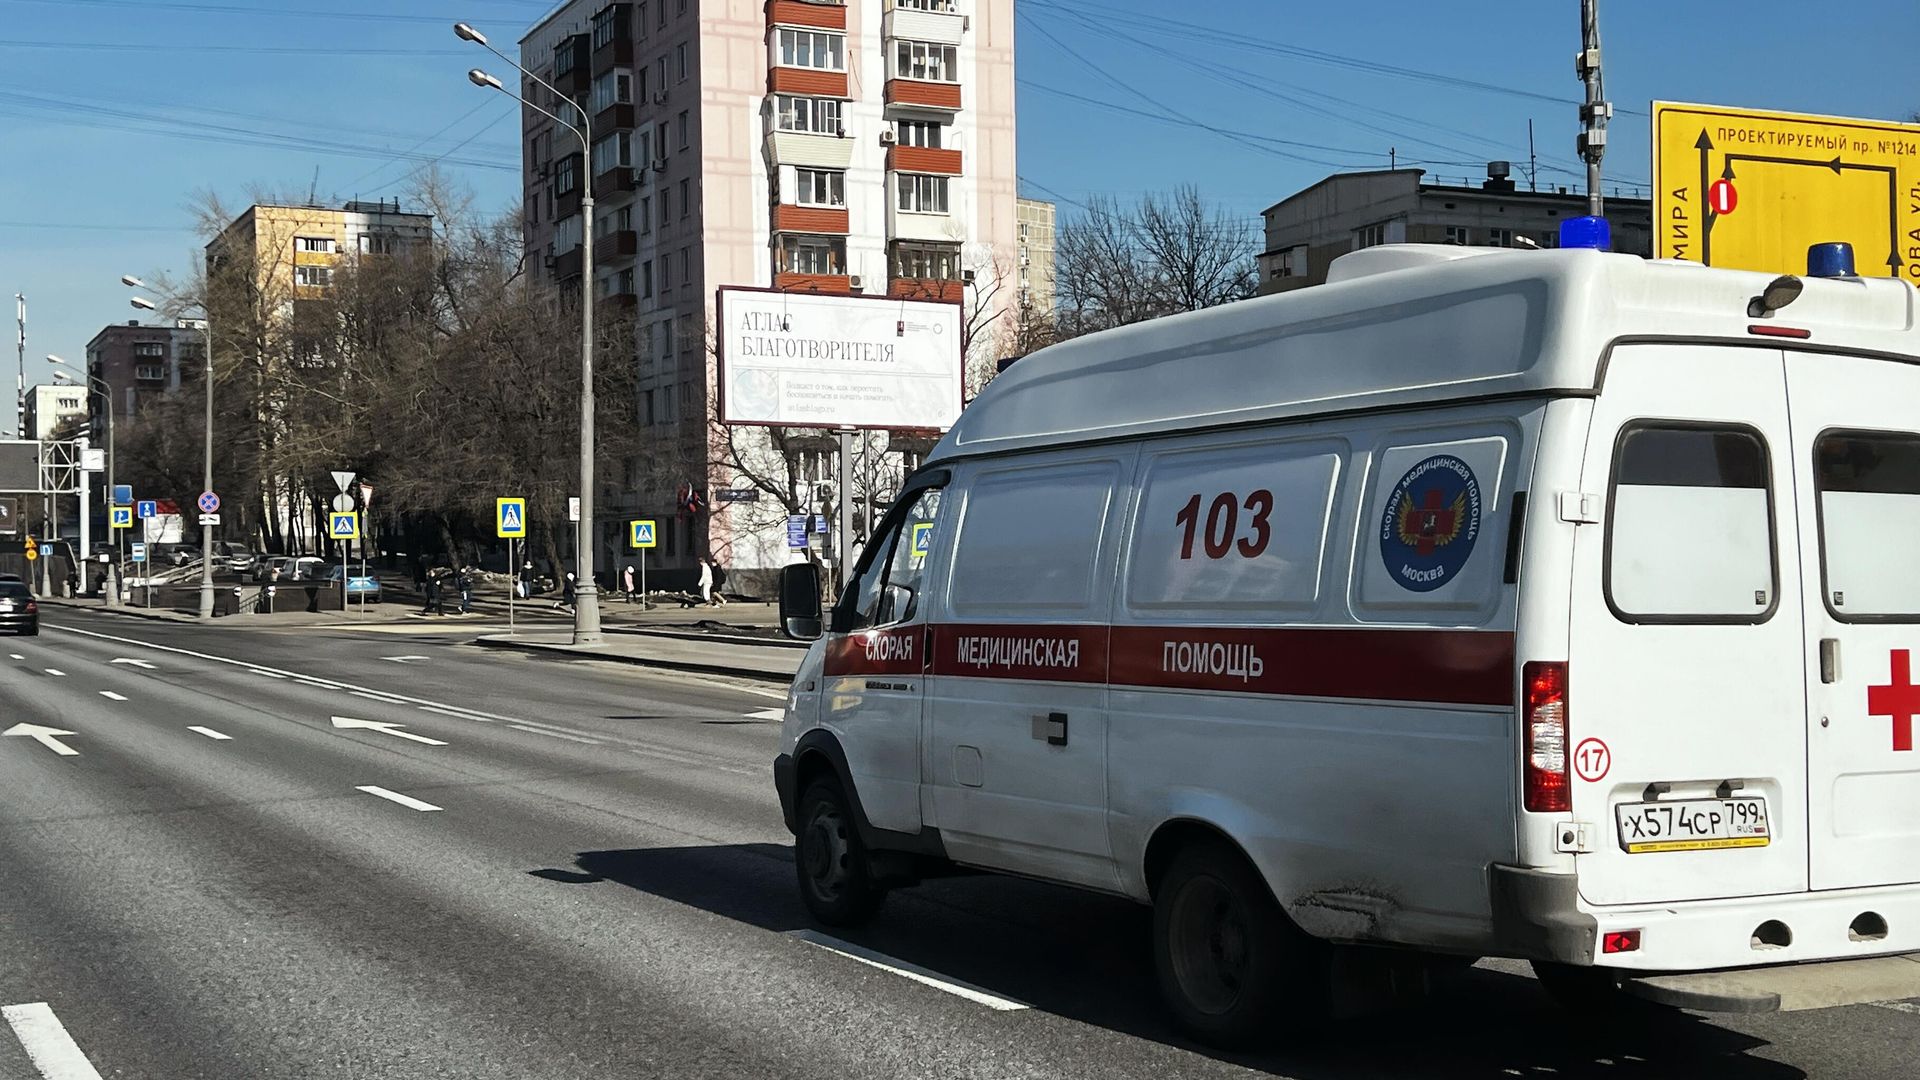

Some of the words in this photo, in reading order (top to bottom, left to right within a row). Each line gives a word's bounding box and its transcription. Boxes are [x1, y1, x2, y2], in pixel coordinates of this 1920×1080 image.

[1717, 127, 1847, 150] ПРОЕКТИРУЕМЫЙ
[1853, 142, 1873, 156] пр.
[1878, 140, 1917, 156] №1214
[1672, 187, 1688, 260] МИРА
[1909, 229, 1920, 290] ОВА
[741, 312, 793, 333] АТЛАС
[741, 336, 895, 363] БЛАГОТВОРИТЕЛЯ
[1175, 489, 1274, 560] 103
[1466, 480, 1479, 540] помощь
[865, 634, 913, 662] СКОРАЯ
[957, 636, 1080, 669] МЕДИЦИНСКАЯ
[1163, 640, 1264, 683] ПОМОЩЬ
[1580, 748, 1604, 772] 17
[1724, 802, 1759, 825] 799
[1736, 825, 1754, 834] RUS
